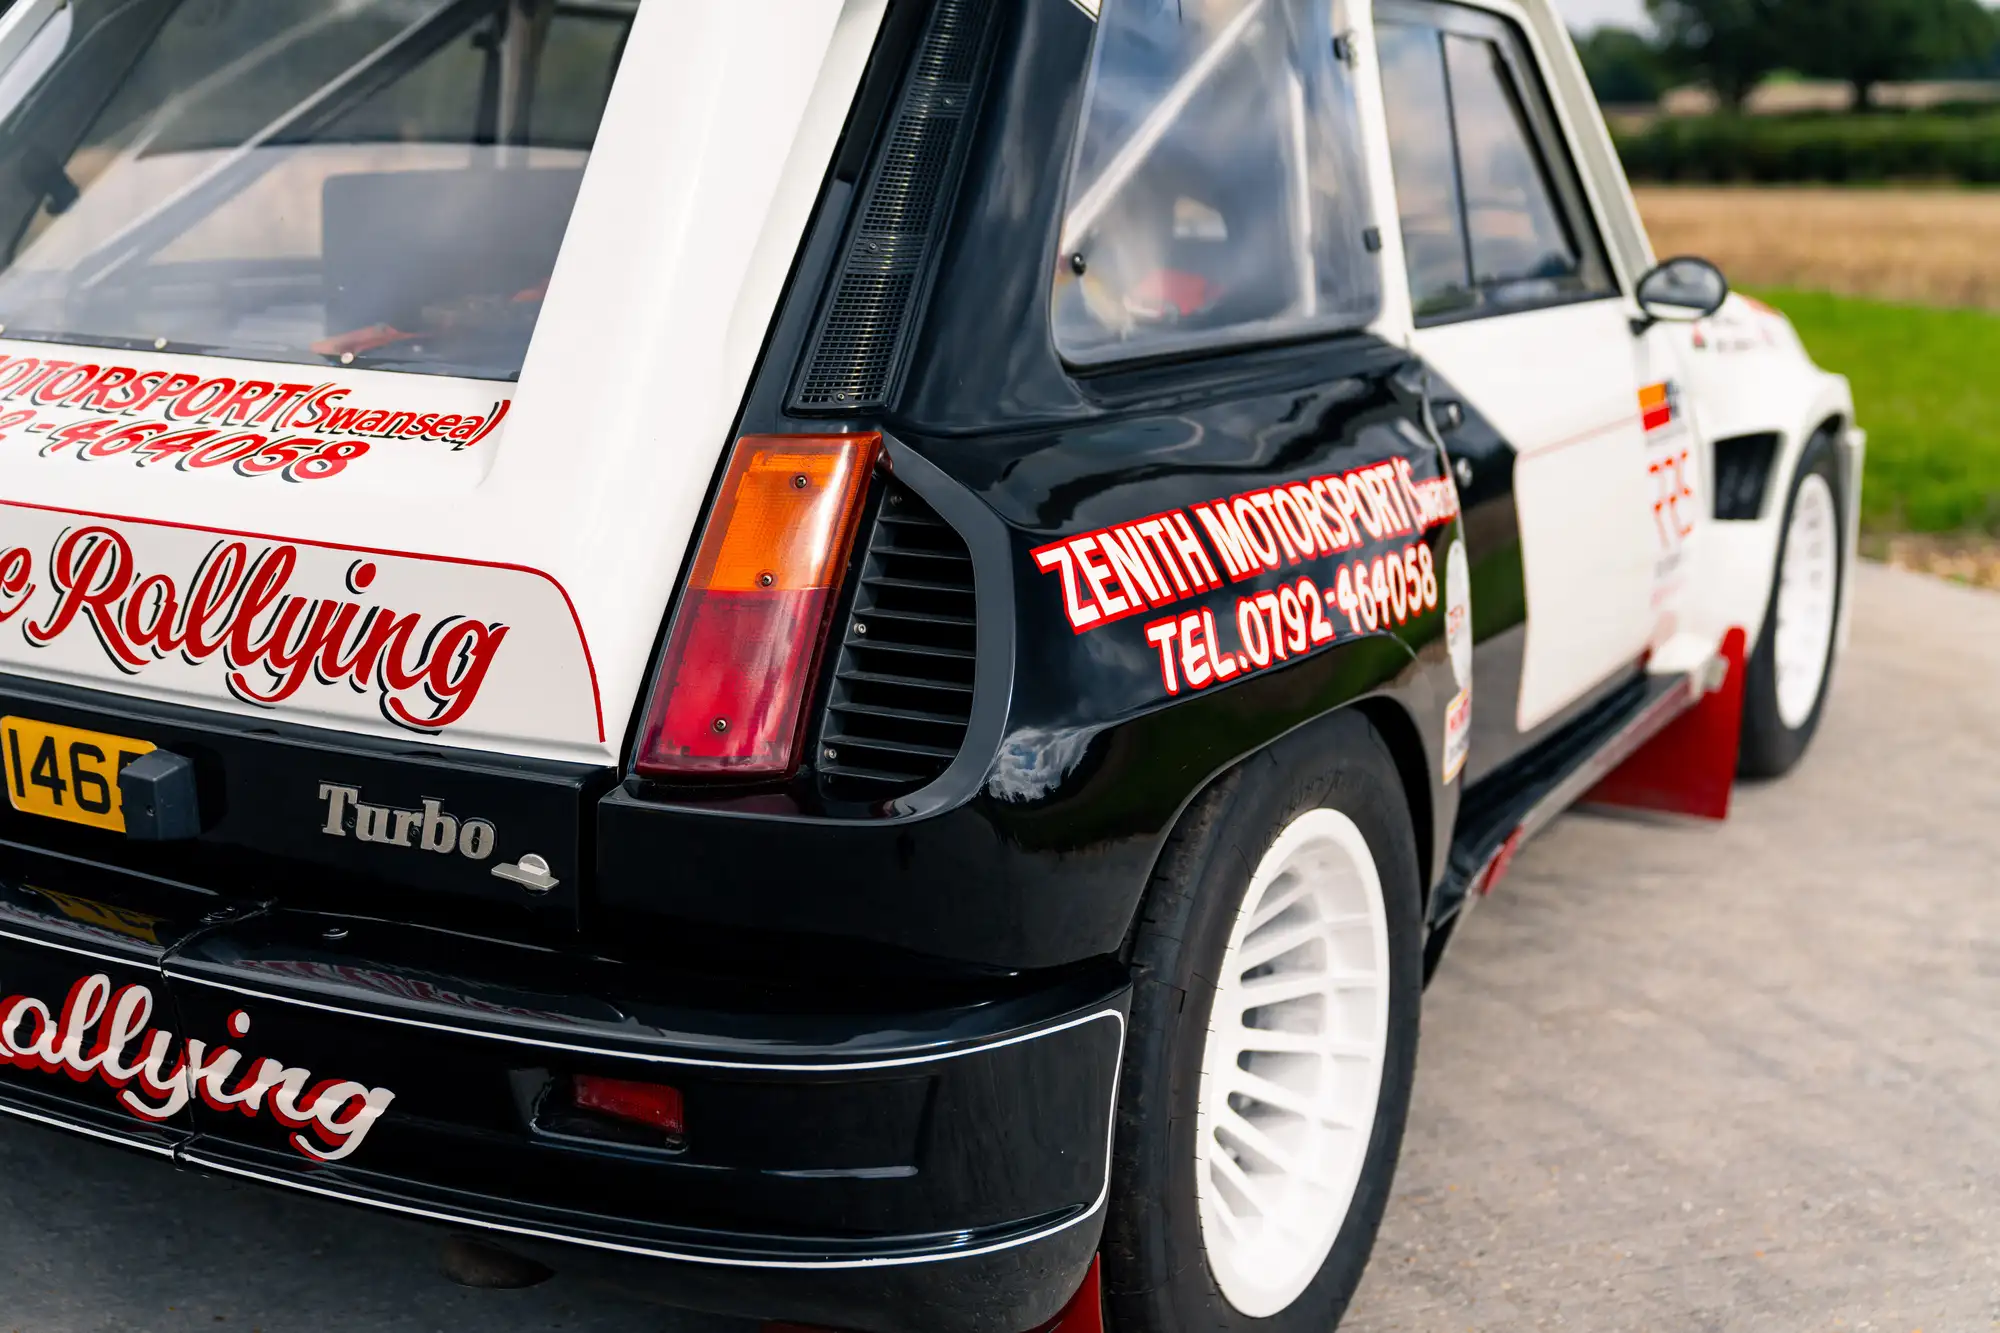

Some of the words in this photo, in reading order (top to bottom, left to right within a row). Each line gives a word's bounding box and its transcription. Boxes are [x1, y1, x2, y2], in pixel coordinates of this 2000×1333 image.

[0, 355, 316, 427] OTORSPORT
[25, 525, 510, 735] Rallying
[1030, 508, 1223, 635] ZENITH
[318, 780, 497, 860] Turbo
[0, 973, 396, 1161] allying
